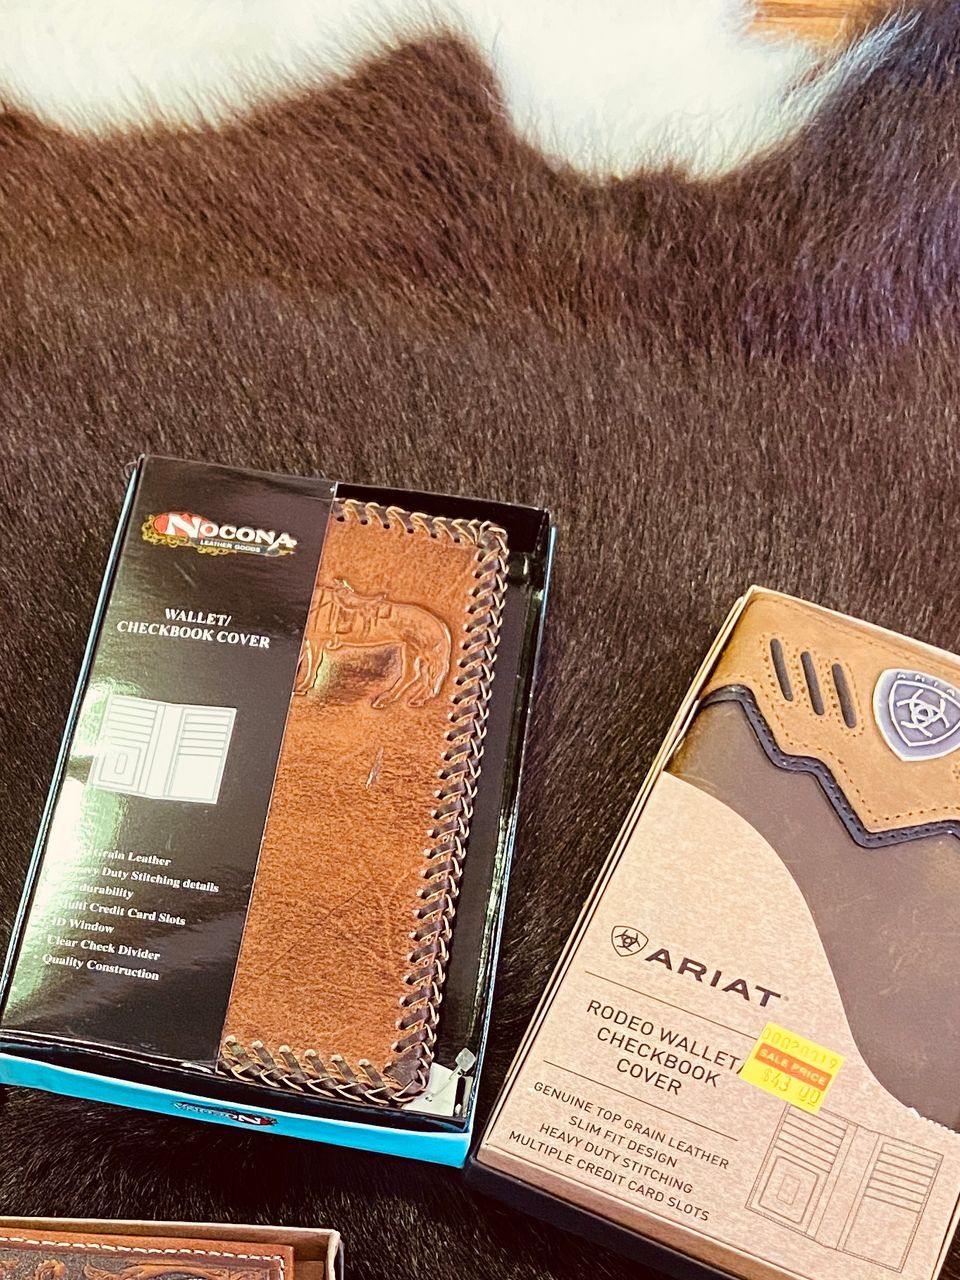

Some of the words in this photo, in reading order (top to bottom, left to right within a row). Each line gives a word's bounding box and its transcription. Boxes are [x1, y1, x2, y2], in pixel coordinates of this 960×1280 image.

[166, 513, 298, 550] NOCONA
[200, 539, 233, 549] LEATHER
[234, 544, 261, 553] GOODS
[165, 608, 232, 627] WALLET/
[117, 621, 215, 641] CHECKBOOK
[216, 631, 271, 649] COVER
[128, 852, 172, 866] Leather
[80, 884, 134, 900] durability
[102, 867, 129, 881] Duty
[131, 871, 180, 888] Stitching
[182, 879, 219, 893] details
[70, 919, 115, 933] Window
[89, 903, 125, 916] Credit
[128, 908, 156, 921] Card
[158, 913, 186, 926] Slots
[80, 939, 115, 953] Check
[118, 944, 161, 961] Divider
[42, 953, 84, 970] Quality
[86, 960, 160, 981] Construction
[644, 948, 781, 1008] ARIAT
[587, 999, 654, 1036] RODEO
[597, 1027, 721, 1088] CHECKBOOK
[760, 1048, 789, 1067] SALE
[791, 1063, 826, 1086] PRICE
[617, 1059, 682, 1095] COVER
[534, 1081, 593, 1113] GENUINE
[596, 1106, 622, 1123] TOP
[624, 1119, 666, 1143] GRAIN
[668, 1137, 729, 1169] LEATHER
[569, 1115, 601, 1136] SLIM
[604, 1130, 626, 1145] FIT
[627, 1140, 678, 1168] DESIGN
[539, 1123, 583, 1147] HEAVY
[585, 1141, 621, 1163] DUTY
[623, 1158, 693, 1194] STITCHING
[509, 1130, 577, 1165] MULTIPLE
[577, 1159, 626, 1186] CREDIT
[628, 1180, 665, 1202] CARD
[667, 1196, 710, 1221] SLOTS
